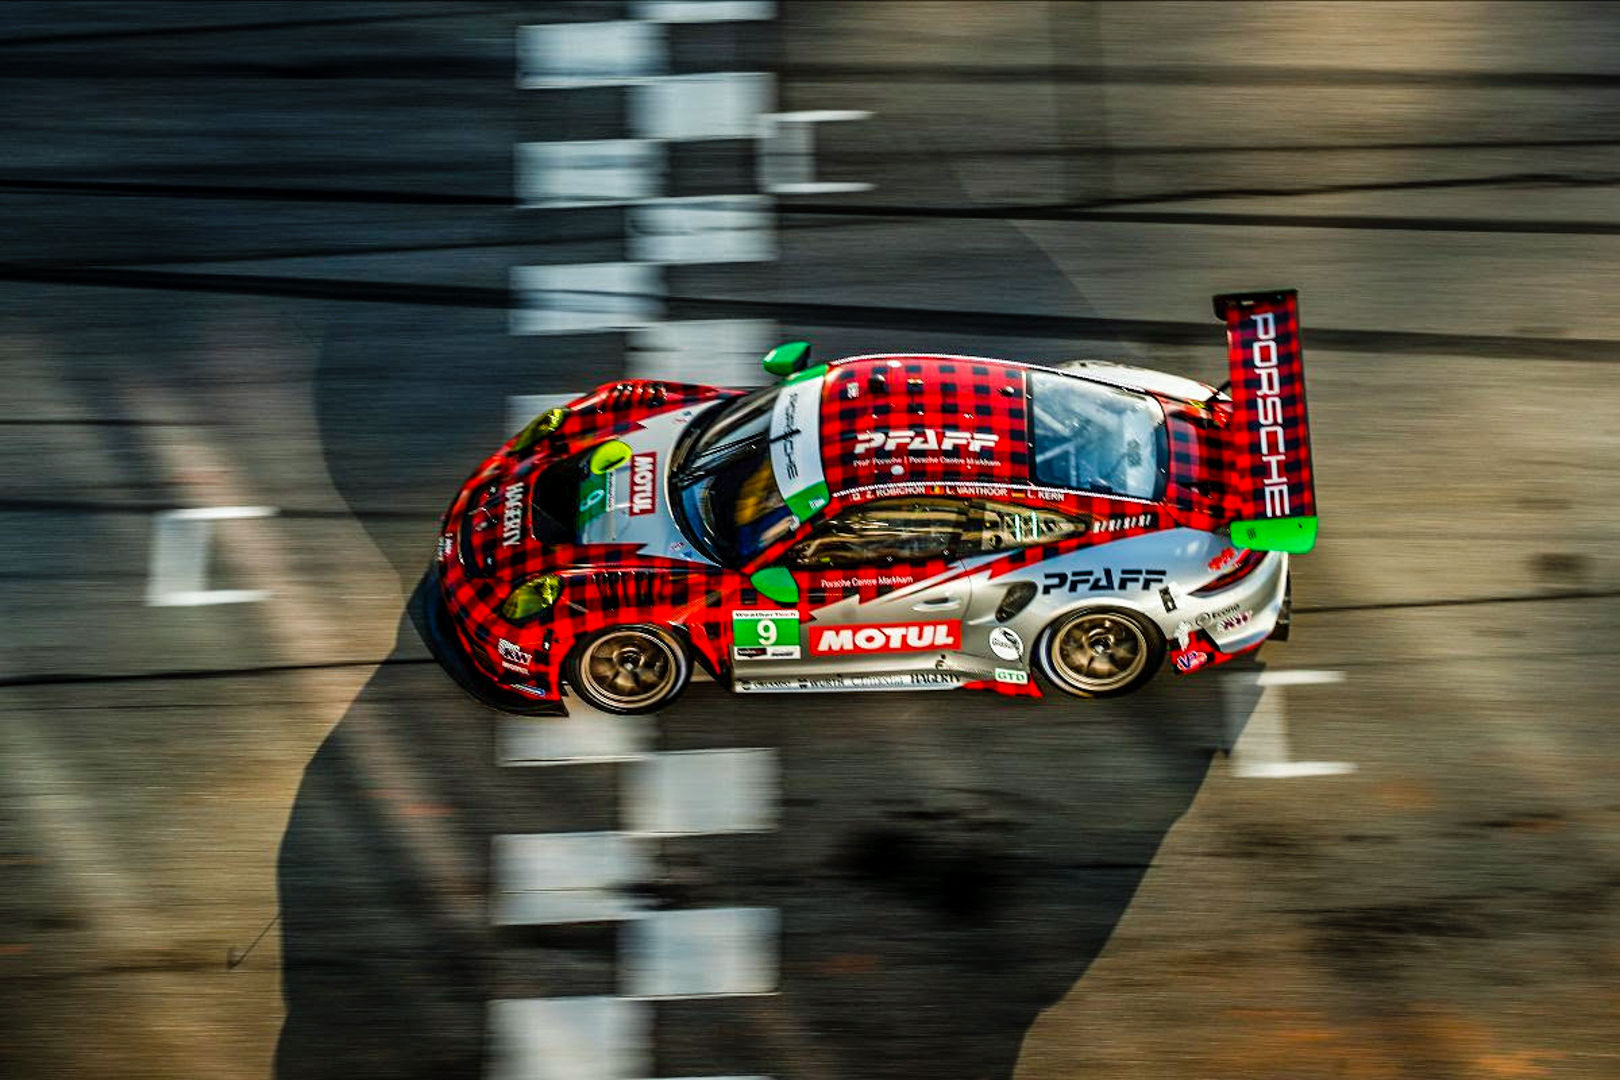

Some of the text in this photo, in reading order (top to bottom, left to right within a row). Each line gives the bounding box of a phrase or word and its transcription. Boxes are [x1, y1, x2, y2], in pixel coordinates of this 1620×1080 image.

[1250, 312, 1290, 517] PORSCHE
[853, 429, 999, 454] PFAFF
[632, 456, 655, 513] MOTUL
[821, 575, 914, 588] Porsche Centre Markham
[1042, 568, 1167, 595] PFAFF
[757, 619, 777, 646] 9
[817, 624, 955, 652] MOTUL
